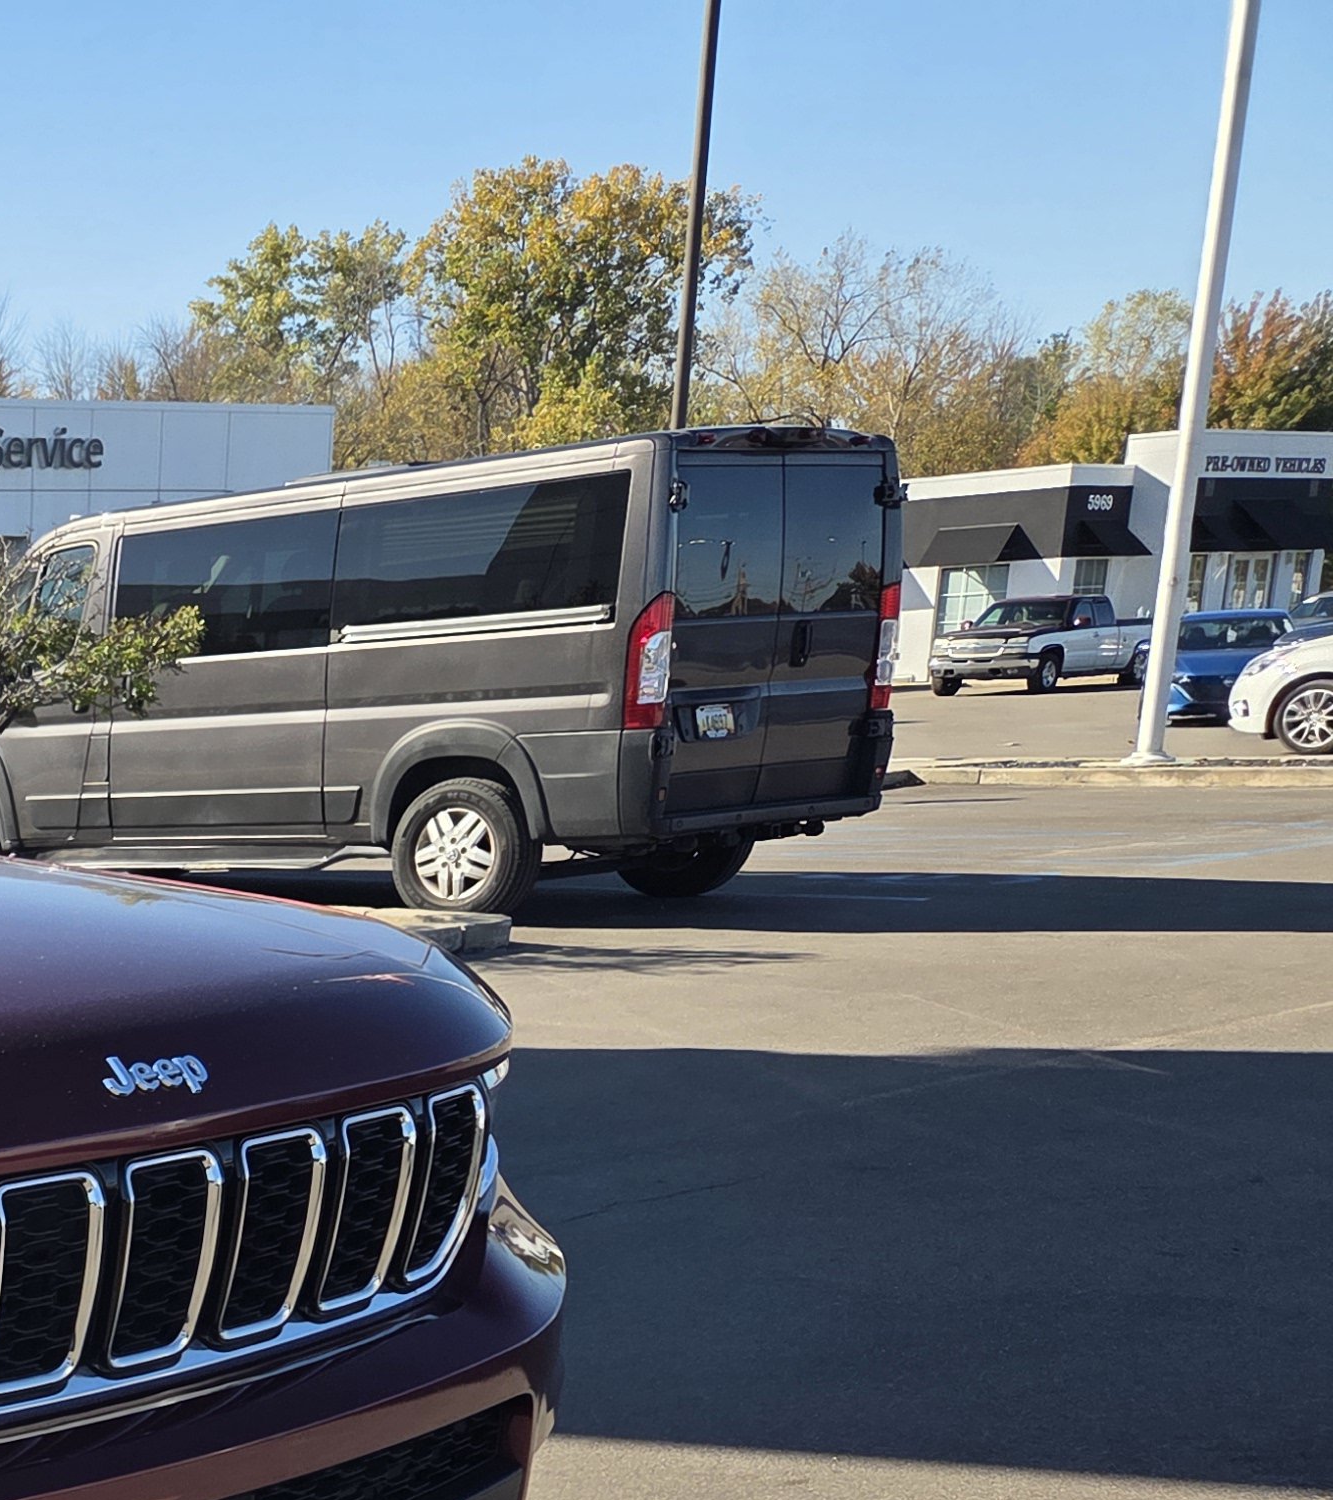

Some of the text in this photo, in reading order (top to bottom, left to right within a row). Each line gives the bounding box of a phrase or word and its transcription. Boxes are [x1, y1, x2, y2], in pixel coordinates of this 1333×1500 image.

[1205, 455, 1327, 474] PRE-OWNED VEHICLES
[1087, 494, 1114, 511] 5969
[102, 1055, 209, 1096] Jeep
